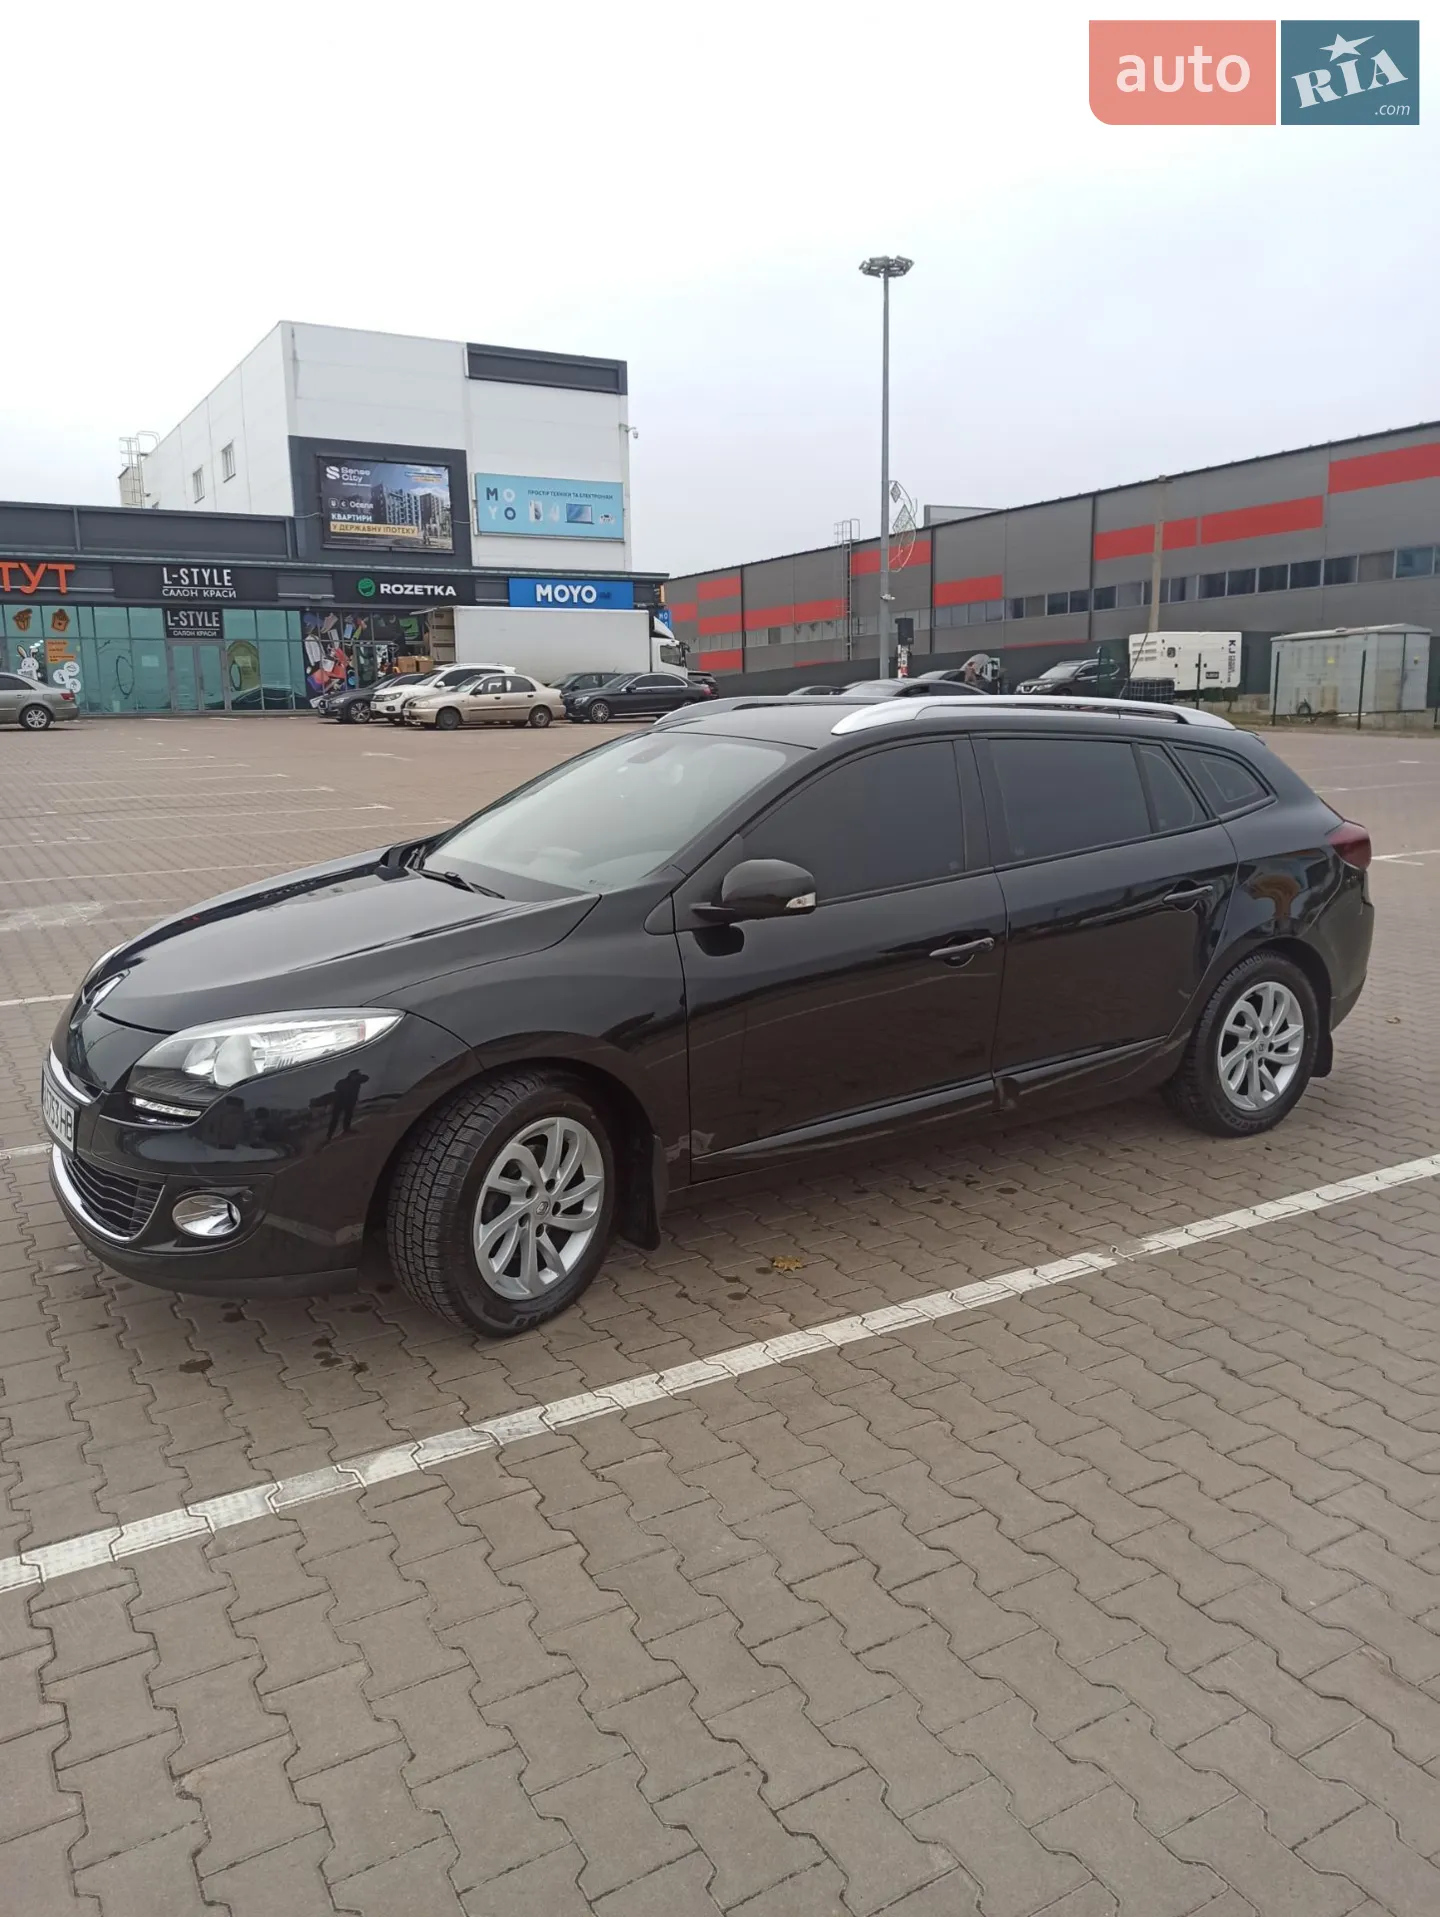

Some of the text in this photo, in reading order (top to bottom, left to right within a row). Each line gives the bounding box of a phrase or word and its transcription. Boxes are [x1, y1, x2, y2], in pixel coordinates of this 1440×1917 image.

[341, 466, 371, 476] Sense
[342, 474, 363, 483] City
[331, 513, 373, 522] КВАРТИРИ
[339, 524, 382, 532] ДЕРЖАВНУ
[383, 525, 417, 534] ІПОТЕКУ
[162, 567, 232, 586] L-STYLE
[162, 588, 237, 598] САЛОН КРАСИ
[380, 583, 457, 597] ROZETKA
[535, 584, 597, 604] MOYO
[167, 610, 220, 627] L-STYLE
